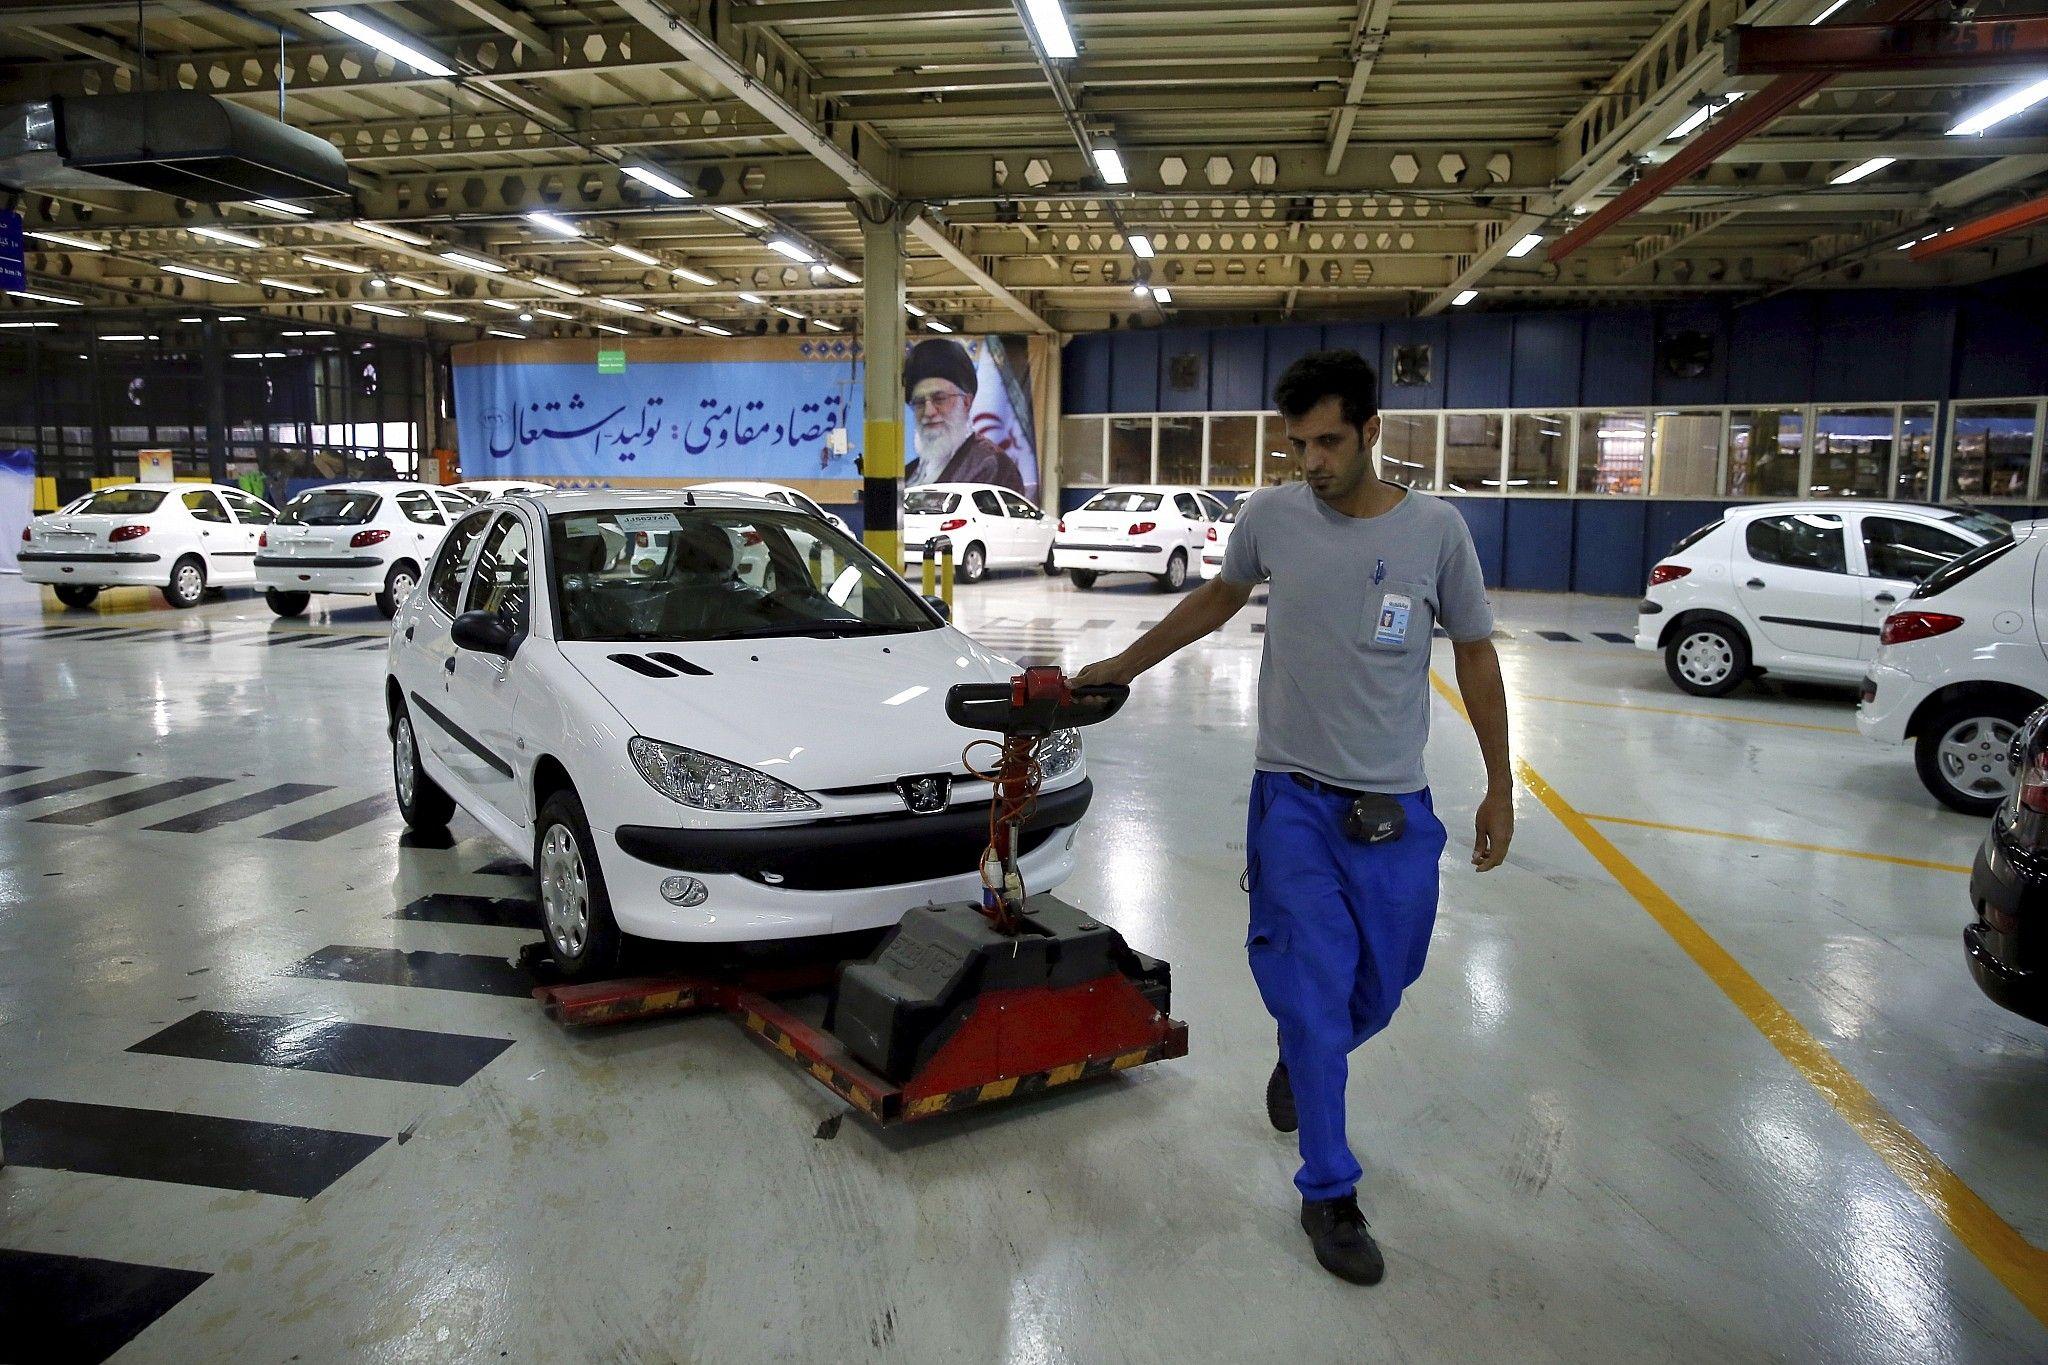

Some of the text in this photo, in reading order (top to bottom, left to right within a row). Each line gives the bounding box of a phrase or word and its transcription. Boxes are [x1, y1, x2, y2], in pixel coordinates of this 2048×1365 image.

[489, 393, 627, 459] اشتغال
[609, 396, 664, 462] تولید
[684, 399, 769, 455] مقاومتی
[771, 395, 849, 447] اقتصاد
[1377, 821, 1392, 831] NIKE
